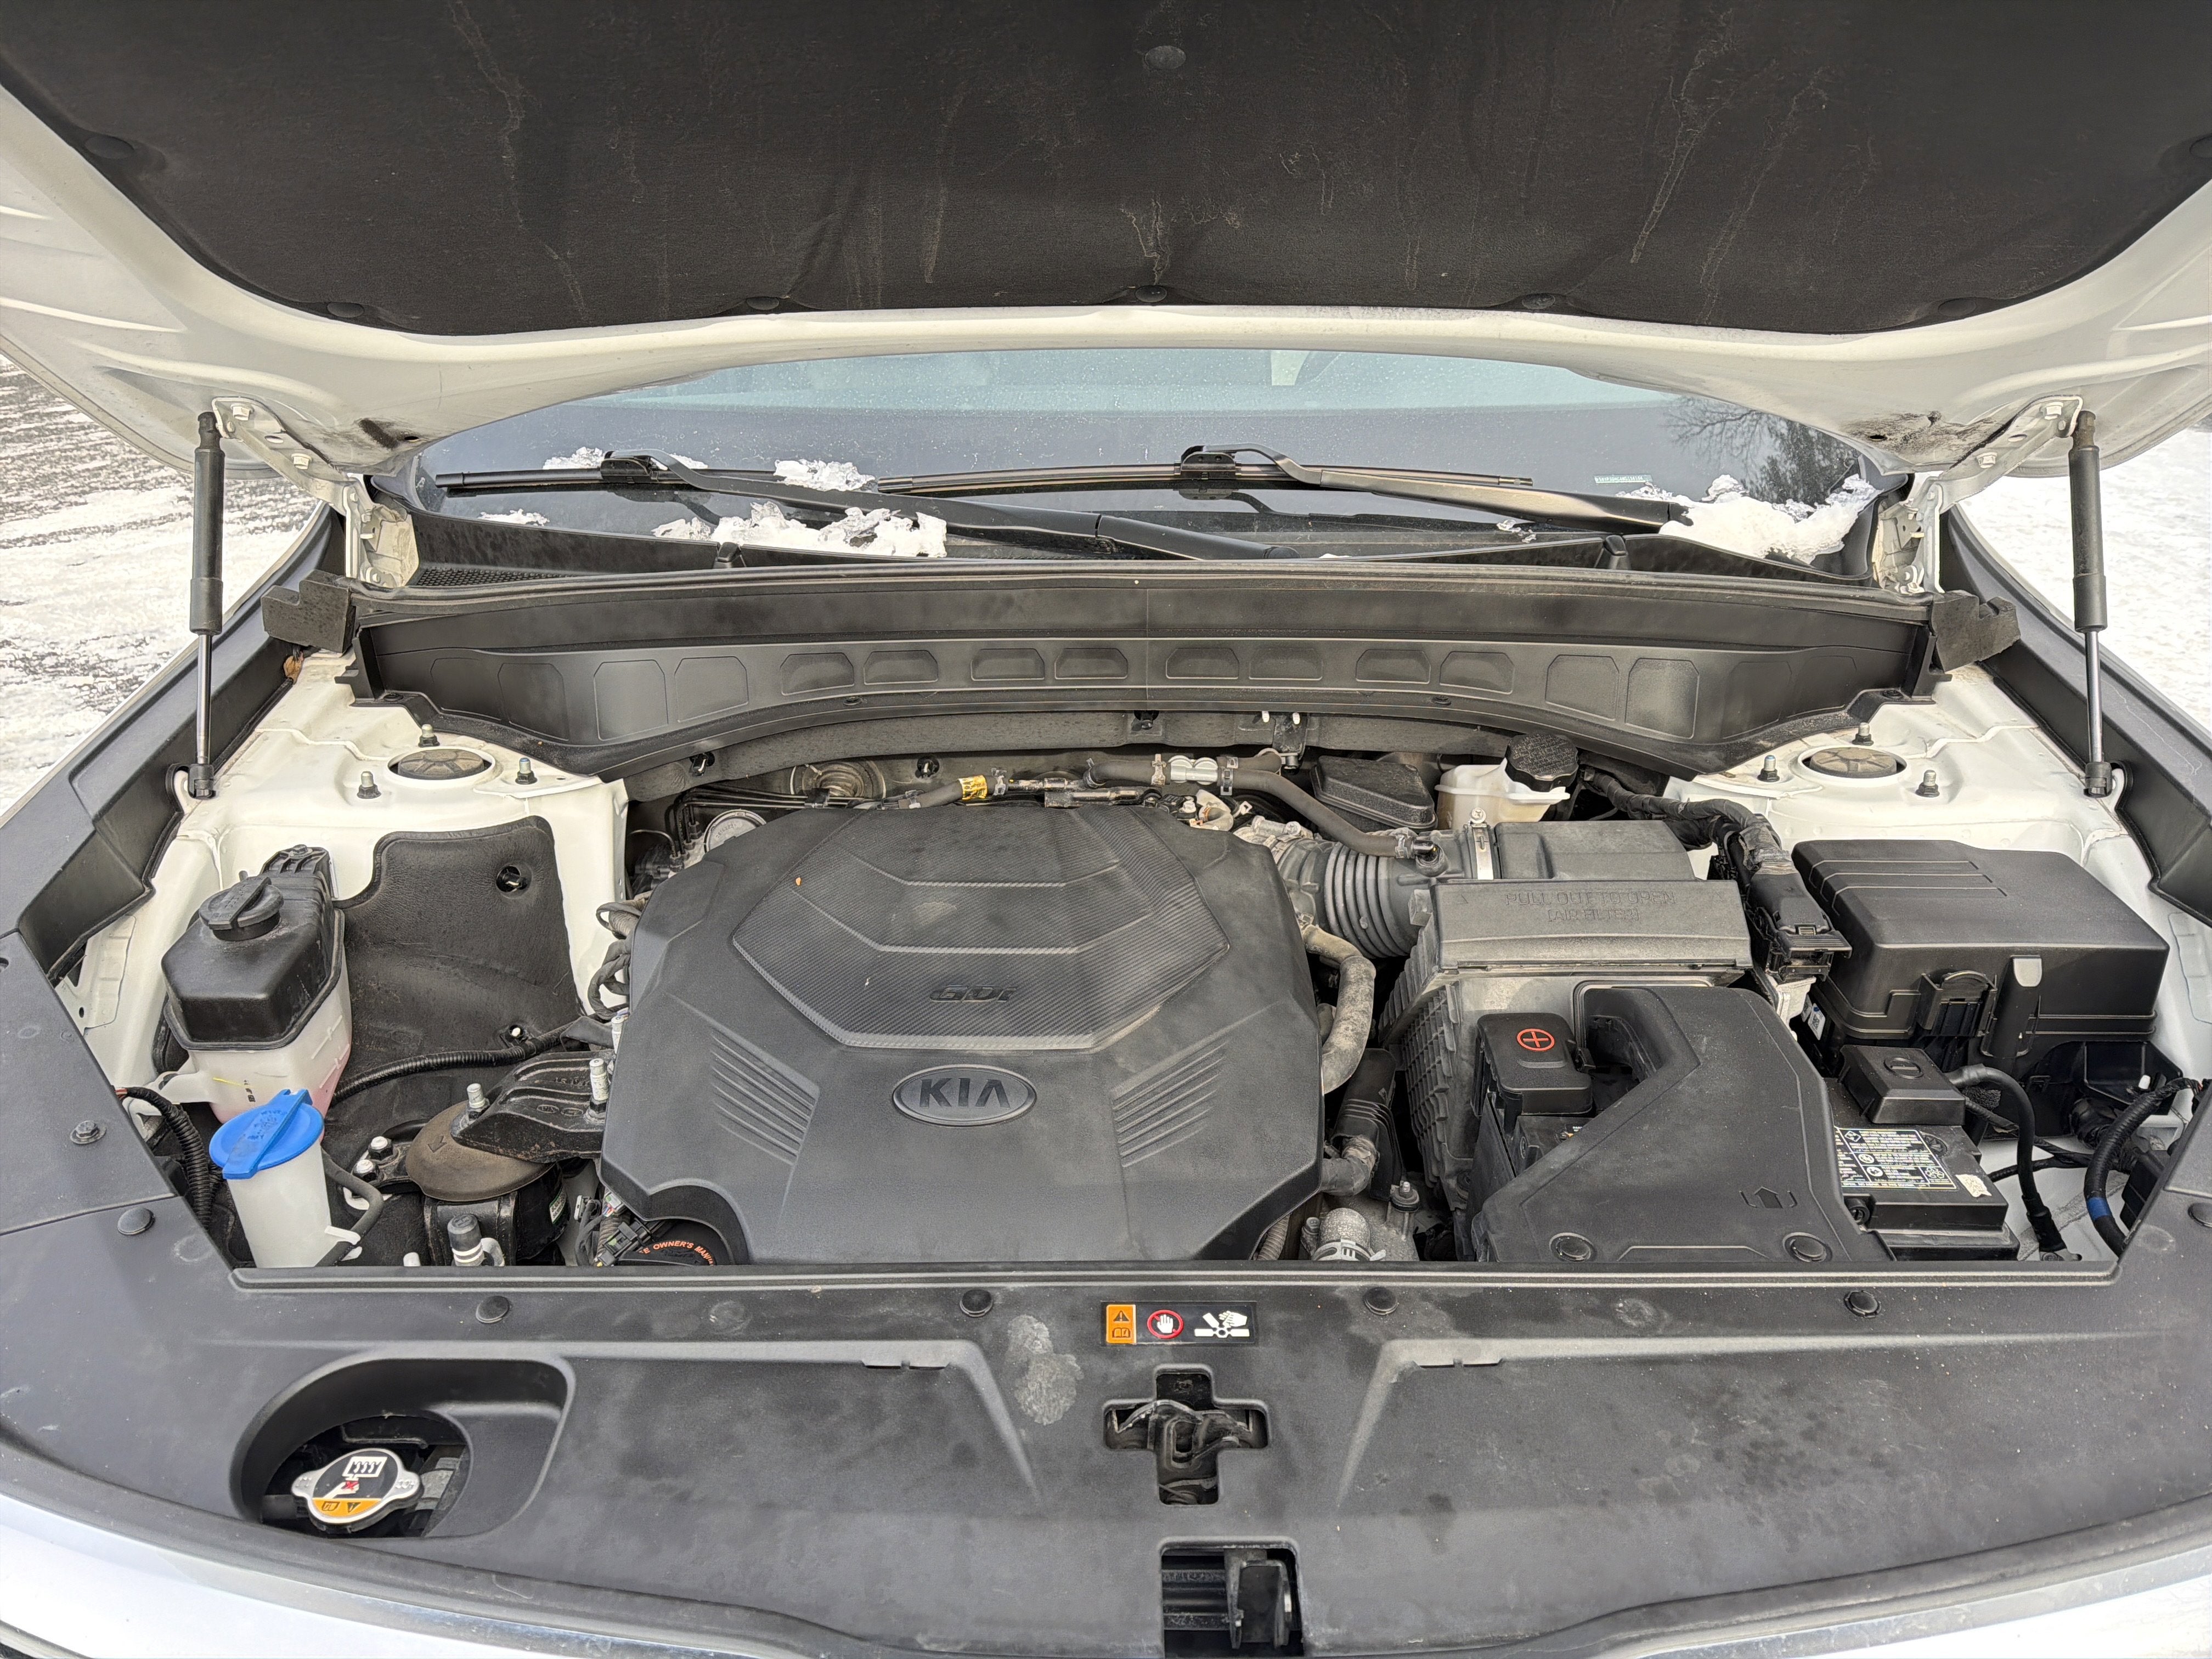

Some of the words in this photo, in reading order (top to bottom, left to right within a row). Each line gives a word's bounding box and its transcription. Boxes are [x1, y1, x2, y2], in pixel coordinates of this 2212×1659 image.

[1506, 891, 1551, 905] PULL
[1557, 890, 1594, 905] OUT
[1596, 890, 1621, 904] TO
[1627, 890, 1676, 904] OPEN
[920, 1077, 1011, 1109] KIA
[653, 1240, 695, 1250] OWNER'S
